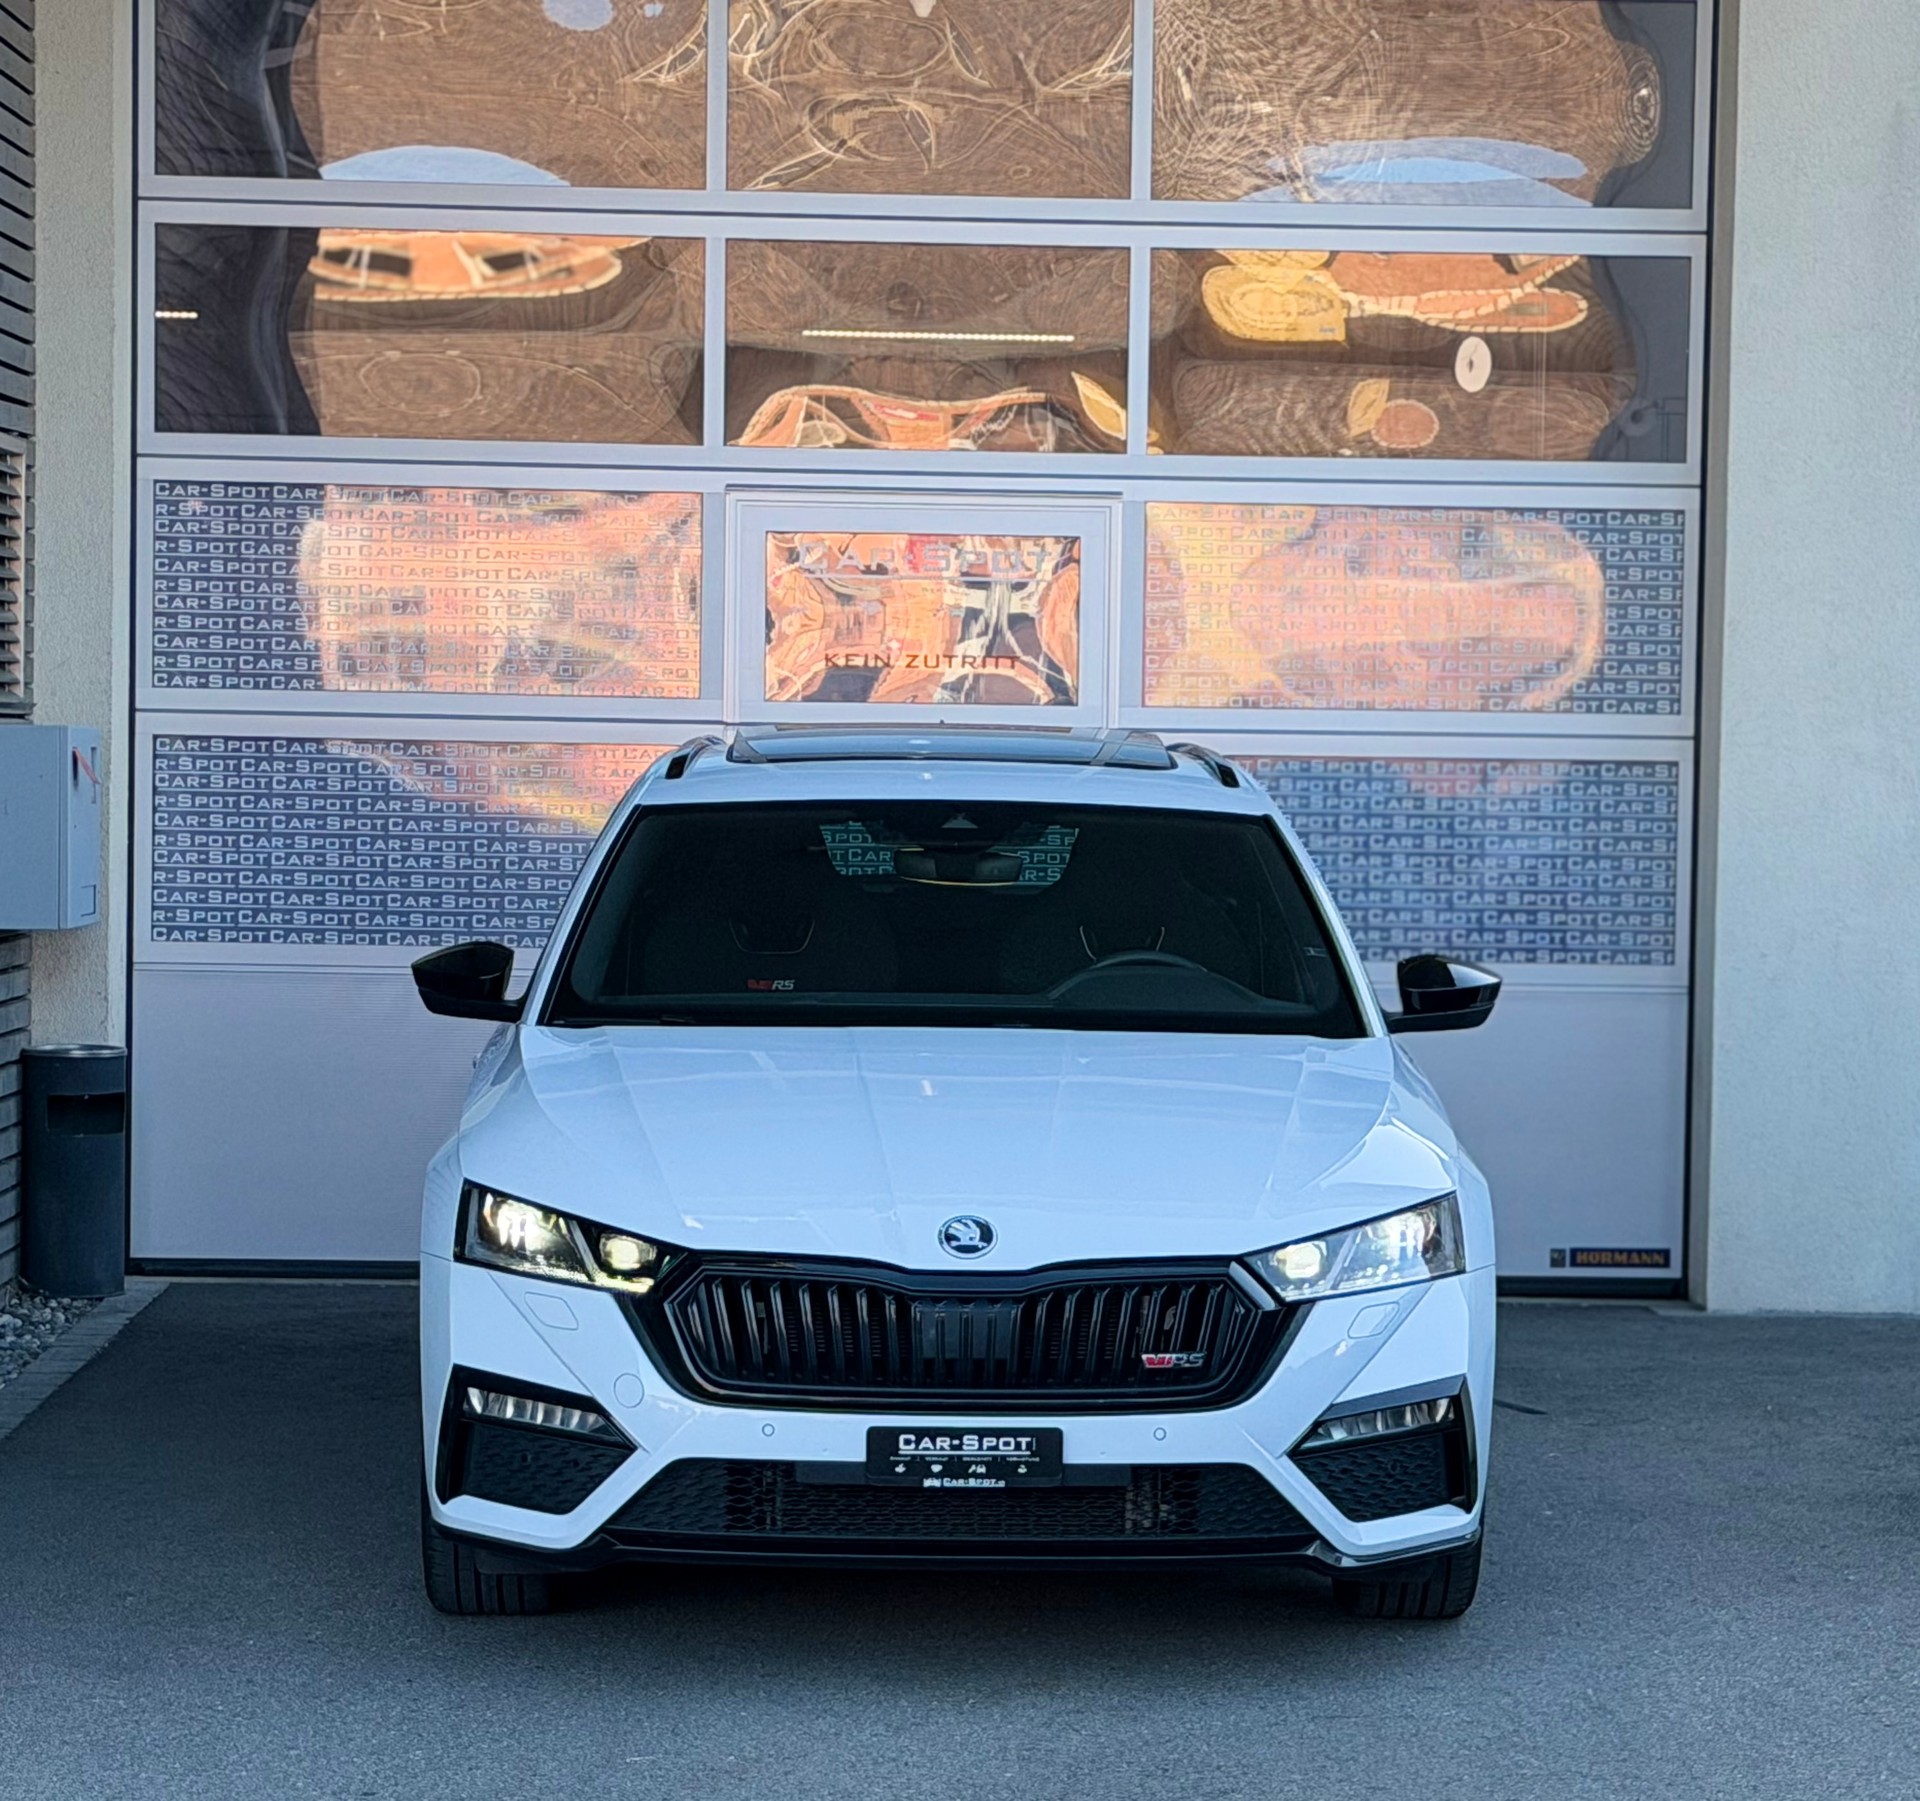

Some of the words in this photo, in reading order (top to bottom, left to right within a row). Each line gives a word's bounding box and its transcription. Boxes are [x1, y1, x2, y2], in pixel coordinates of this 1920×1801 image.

[155, 483, 270, 499] CAR-SPOT
[241, 503, 356, 519] CAR-SPOT
[155, 519, 270, 536] CAR-SPOT
[272, 522, 387, 539] CASPOT
[155, 558, 270, 574] CAR-SPOT
[272, 561, 387, 577] CASPOT
[154, 595, 270, 611] CAR-SPOT
[1574, 605, 1681, 619] CR-SPOT
[154, 634, 269, 651] CAR-SPOT
[824, 653, 891, 668] KEIN
[905, 654, 1021, 670] ZUTRITT
[1489, 659, 1602, 674] CAR-ST
[154, 673, 269, 689] CAR-SPOT
[155, 738, 270, 754] CAR-SPOT
[389, 743, 504, 758] CAR-SPOT
[240, 758, 355, 773] CAR-SPOT
[357, 760, 472, 775] CAR-SPOT
[1372, 760, 1484, 775] CAR-SPOT
[1486, 762, 1599, 776] CAR-SPOT
[155, 774, 270, 789] CAR-SPOT
[272, 776, 386, 792] CAR-SPOT
[1340, 779, 1453, 793] CAR-SPOT
[1455, 780, 1567, 795] CAR-SPOT
[240, 795, 355, 811] CAR-SPOT
[357, 797, 471, 813] CAR-SPOT
[1371, 797, 1483, 811] CAR-SPOT
[1485, 798, 1598, 812] CAR-SPOT
[154, 813, 269, 828] CAR-SPOT
[271, 815, 386, 830] CAR-SPOT
[388, 817, 503, 833] CAR-SPOT
[1339, 815, 1452, 830] CAR-SPOT
[1454, 817, 1567, 831] CAR-SPOT
[239, 834, 354, 849] CAR-SPOT
[356, 836, 471, 852] CAR-SPOT
[473, 838, 588, 854] CAR-SPOT
[1370, 835, 1482, 849] CAR-SPOT
[1484, 836, 1597, 851] CAR-SPOT
[154, 850, 269, 866] CAR-SPOT
[271, 852, 385, 868] CAR-SPOT
[387, 855, 502, 870] CAR-SPOT
[1338, 854, 1451, 868] CAR-SPOT
[1453, 855, 1566, 869] CAR-SPOT
[239, 869, 354, 885] CAR-SPOT
[356, 872, 470, 887] CAR-SPOT
[1369, 871, 1482, 885] CAR-SPOT
[1484, 872, 1596, 886] CAR-SPOT
[153, 889, 268, 904] CAR-SPOT
[270, 891, 385, 907] CAR-SPOT
[387, 893, 502, 909] CAR-SPOT
[1338, 889, 1450, 904] CAR-SPOT
[1452, 891, 1565, 905] CAR-SPOT
[238, 908, 353, 924] CAR-SPOT
[355, 910, 470, 926] CAR-SPOT
[1368, 908, 1481, 923] CAR-SPOT
[1483, 910, 1595, 924] CAR-SPOT
[153, 927, 268, 943] CAR-SPOT
[270, 930, 385, 945] CAR-SPOT
[1451, 930, 1564, 944] CAR-SPOT
[1482, 947, 1595, 961] CAR-SPOT
[898, 1434, 1032, 1450] CAR-SPOT
